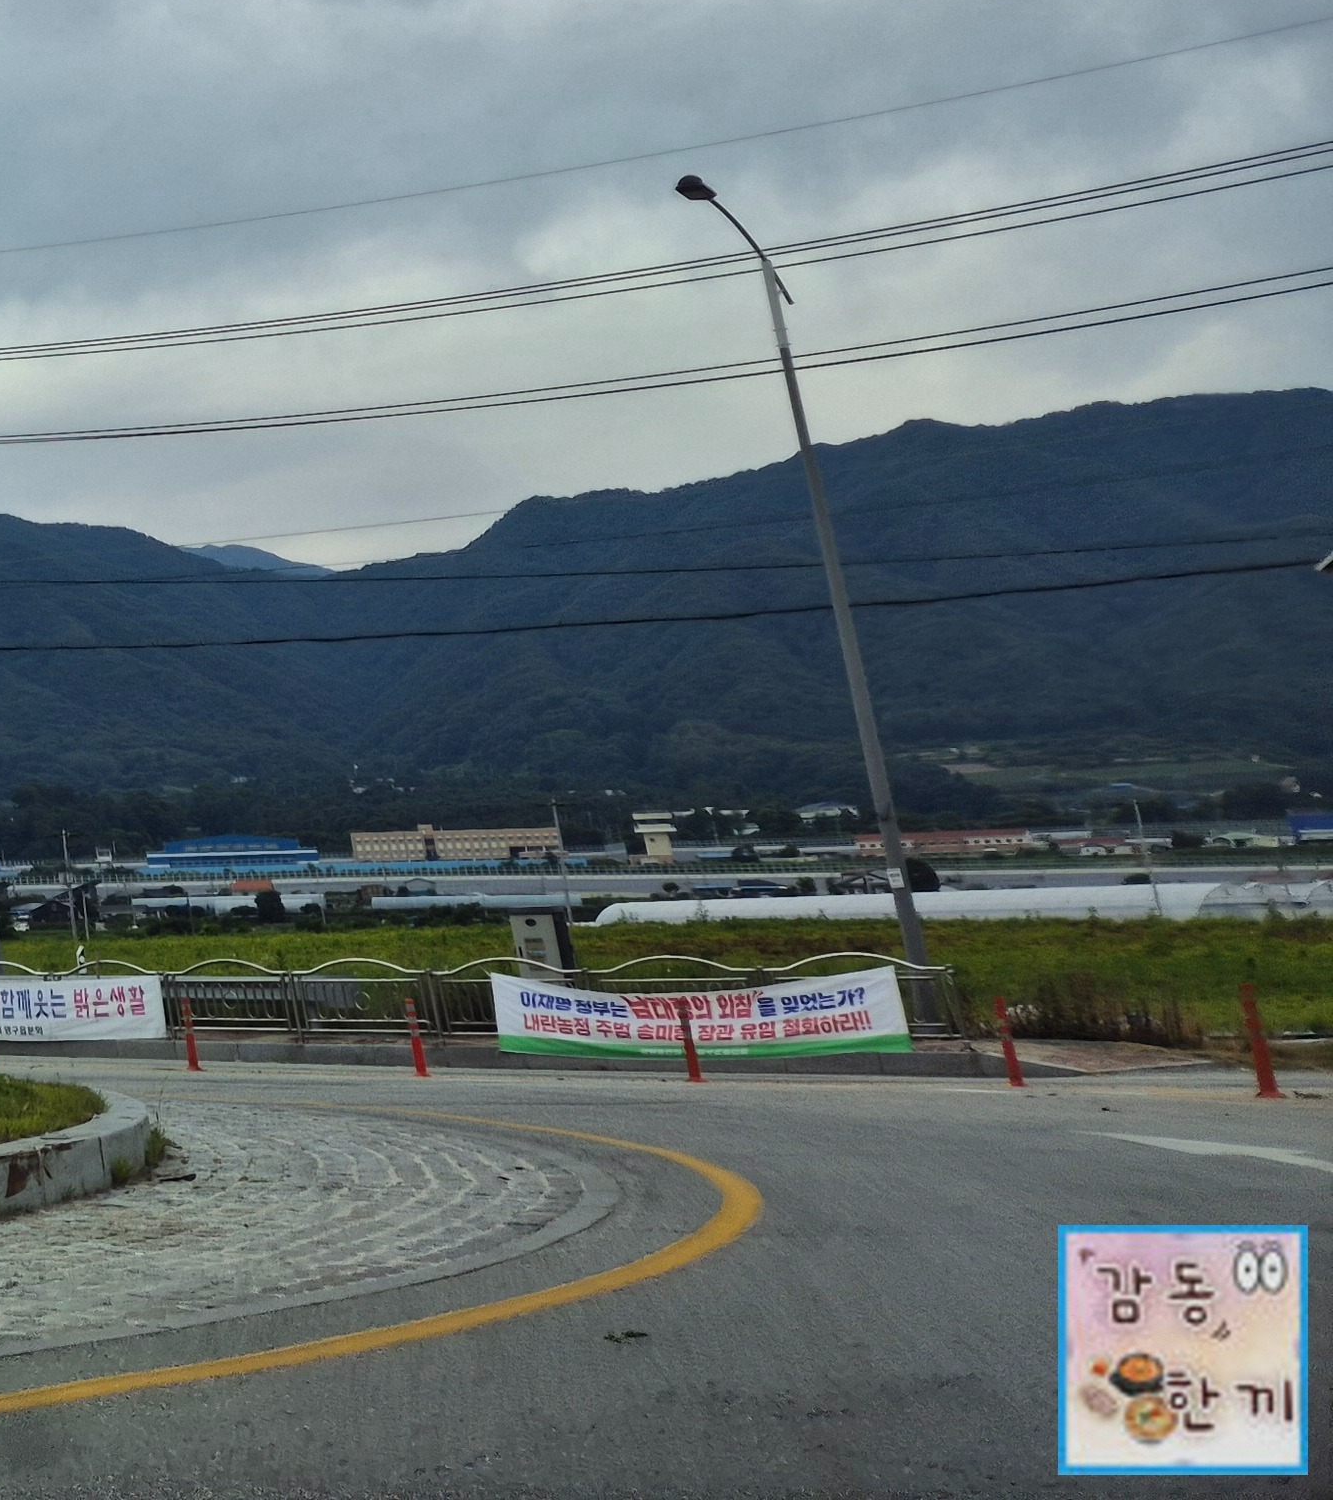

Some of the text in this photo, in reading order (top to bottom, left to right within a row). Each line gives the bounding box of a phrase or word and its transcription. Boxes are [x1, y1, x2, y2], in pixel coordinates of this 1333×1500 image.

[519, 991, 572, 1012] 이재명
[574, 998, 629, 1019] 정부는
[780, 986, 866, 1015] 잊었는가?
[523, 1013, 591, 1037] 내란농정
[595, 1018, 632, 1040] 주범
[697, 1022, 735, 1042] 장관
[740, 1020, 777, 1041] 유임
[782, 1009, 873, 1038] 철회하라!!
